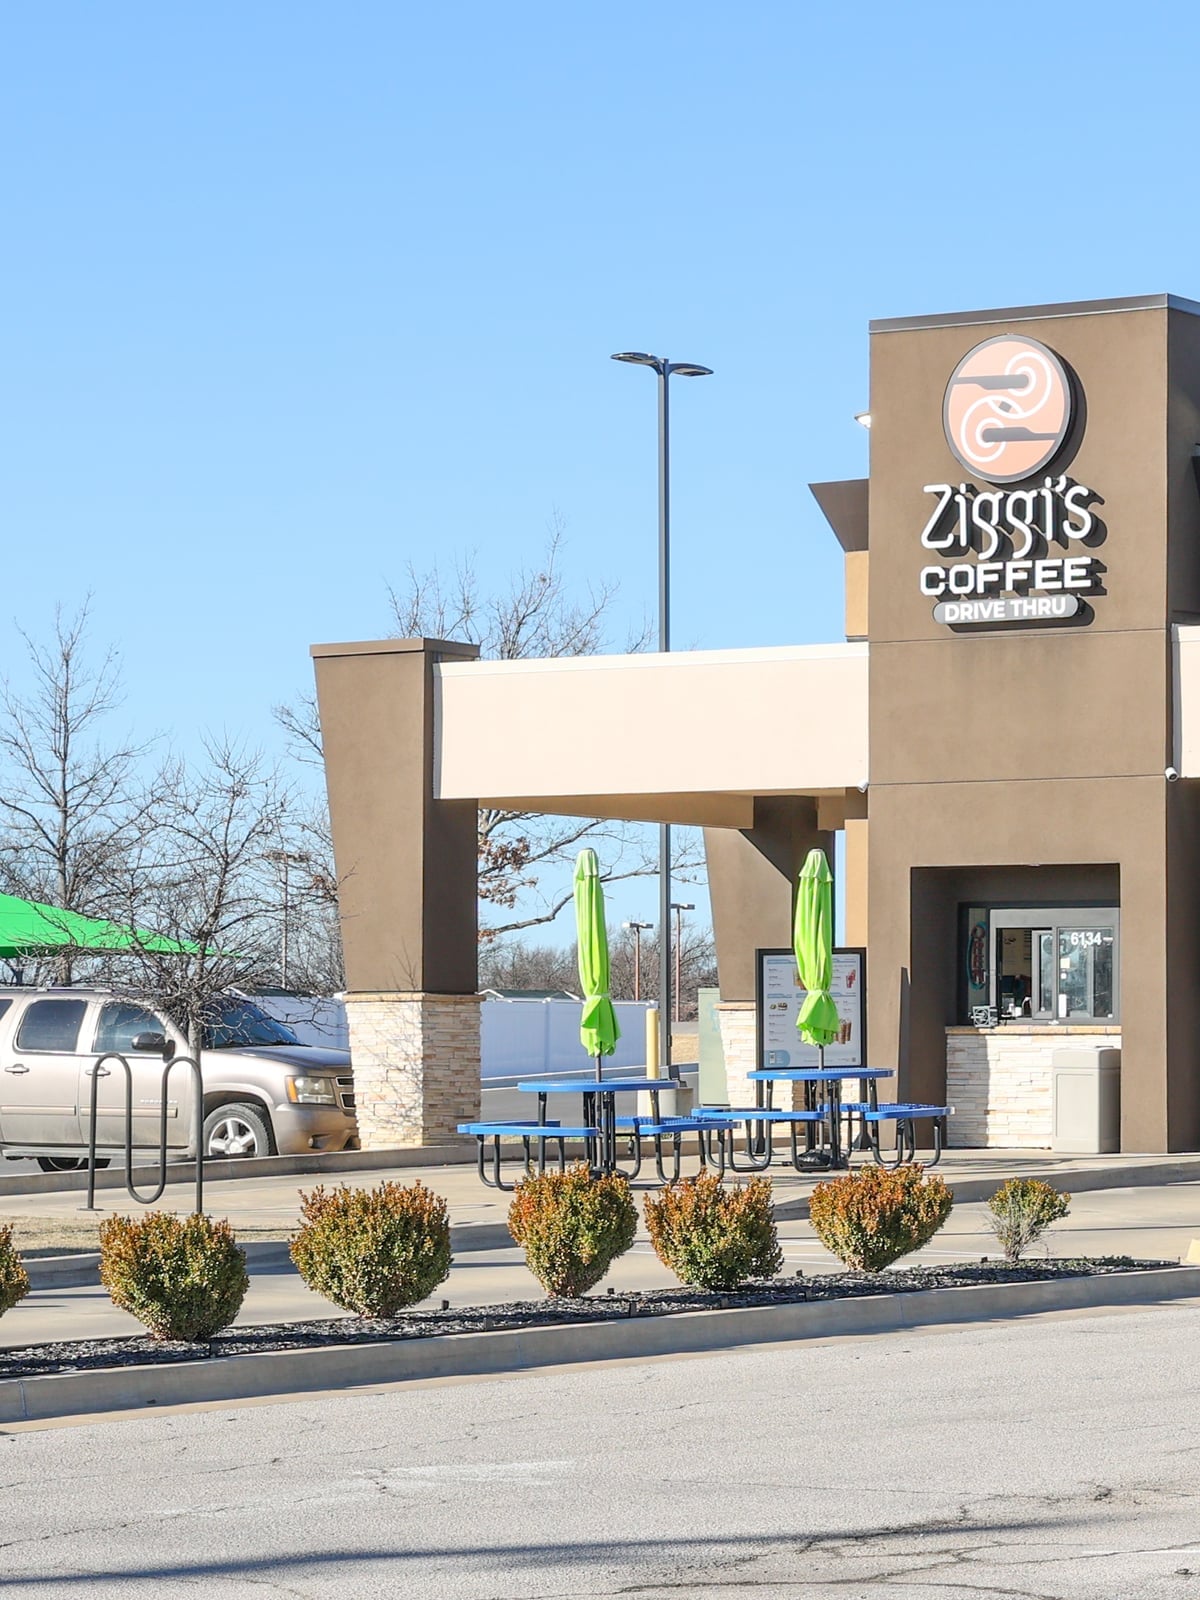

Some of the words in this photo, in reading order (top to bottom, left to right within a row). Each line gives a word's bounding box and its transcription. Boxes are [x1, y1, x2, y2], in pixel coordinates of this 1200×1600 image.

[921, 474, 1092, 560] Ziggi's
[920, 557, 1092, 595] COFFEE
[944, 601, 1006, 622] DRIVE
[1010, 597, 1066, 617] THRU
[1070, 931, 1103, 946] 6134
